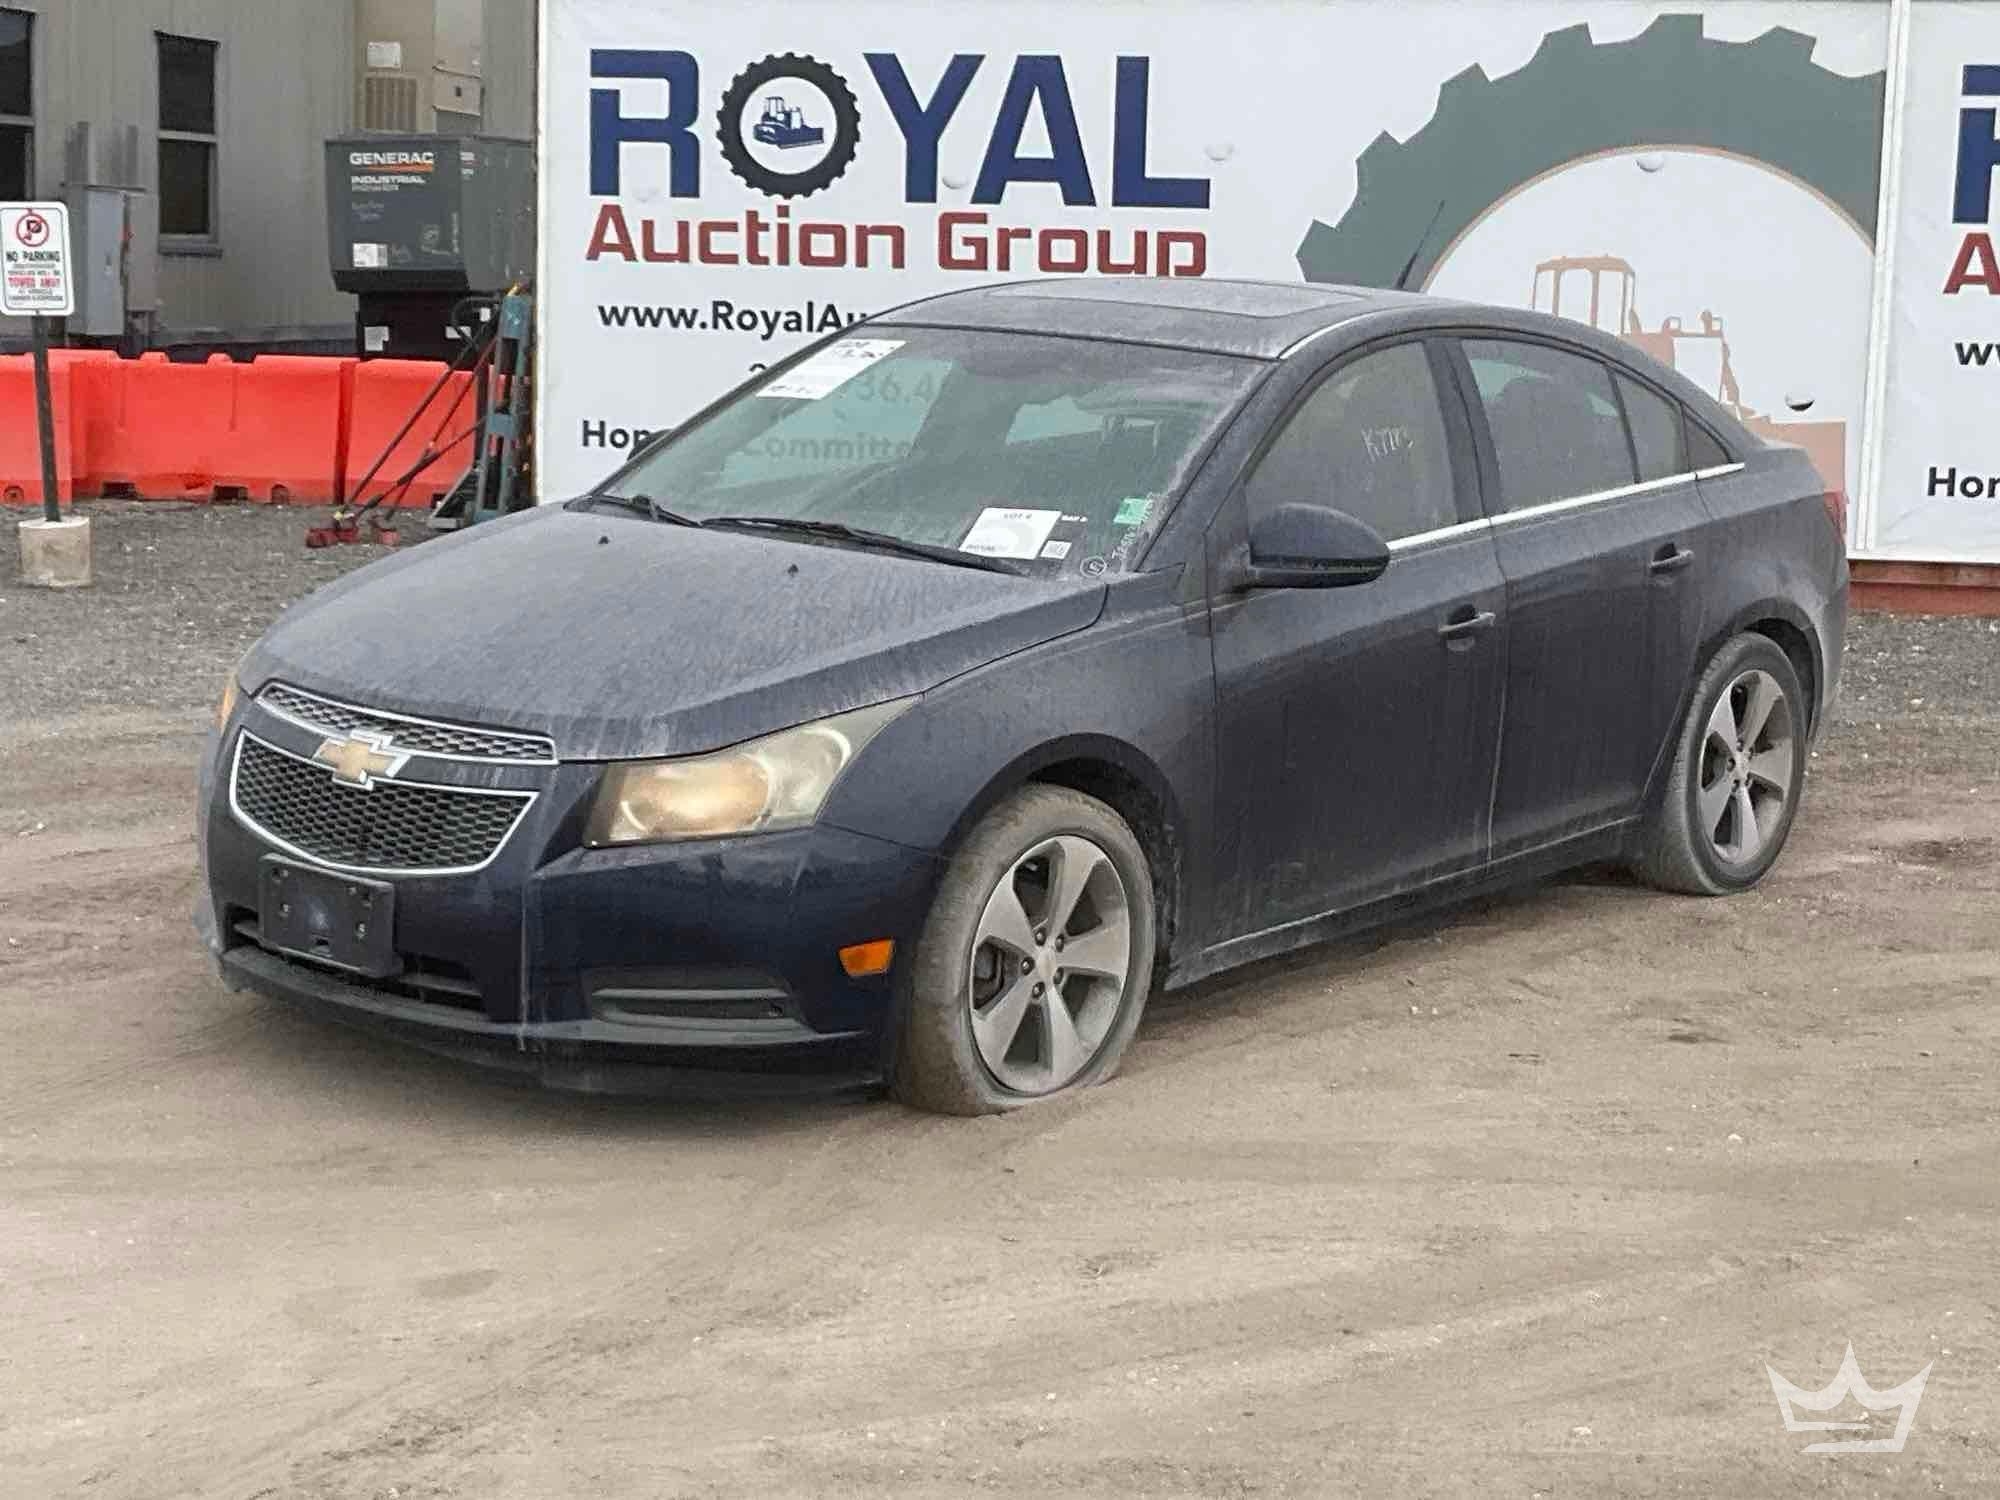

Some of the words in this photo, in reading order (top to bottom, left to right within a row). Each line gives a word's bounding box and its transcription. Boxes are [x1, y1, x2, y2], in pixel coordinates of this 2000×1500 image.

[590, 48, 1210, 208] ROYAL
[350, 152, 434, 165] GENERAC
[351, 175, 426, 184] INDUSTRIAL
[586, 204, 905, 269] Auction
[938, 211, 1208, 277] Group
[6, 250, 18, 262] NO
[22, 250, 61, 262] PARKING
